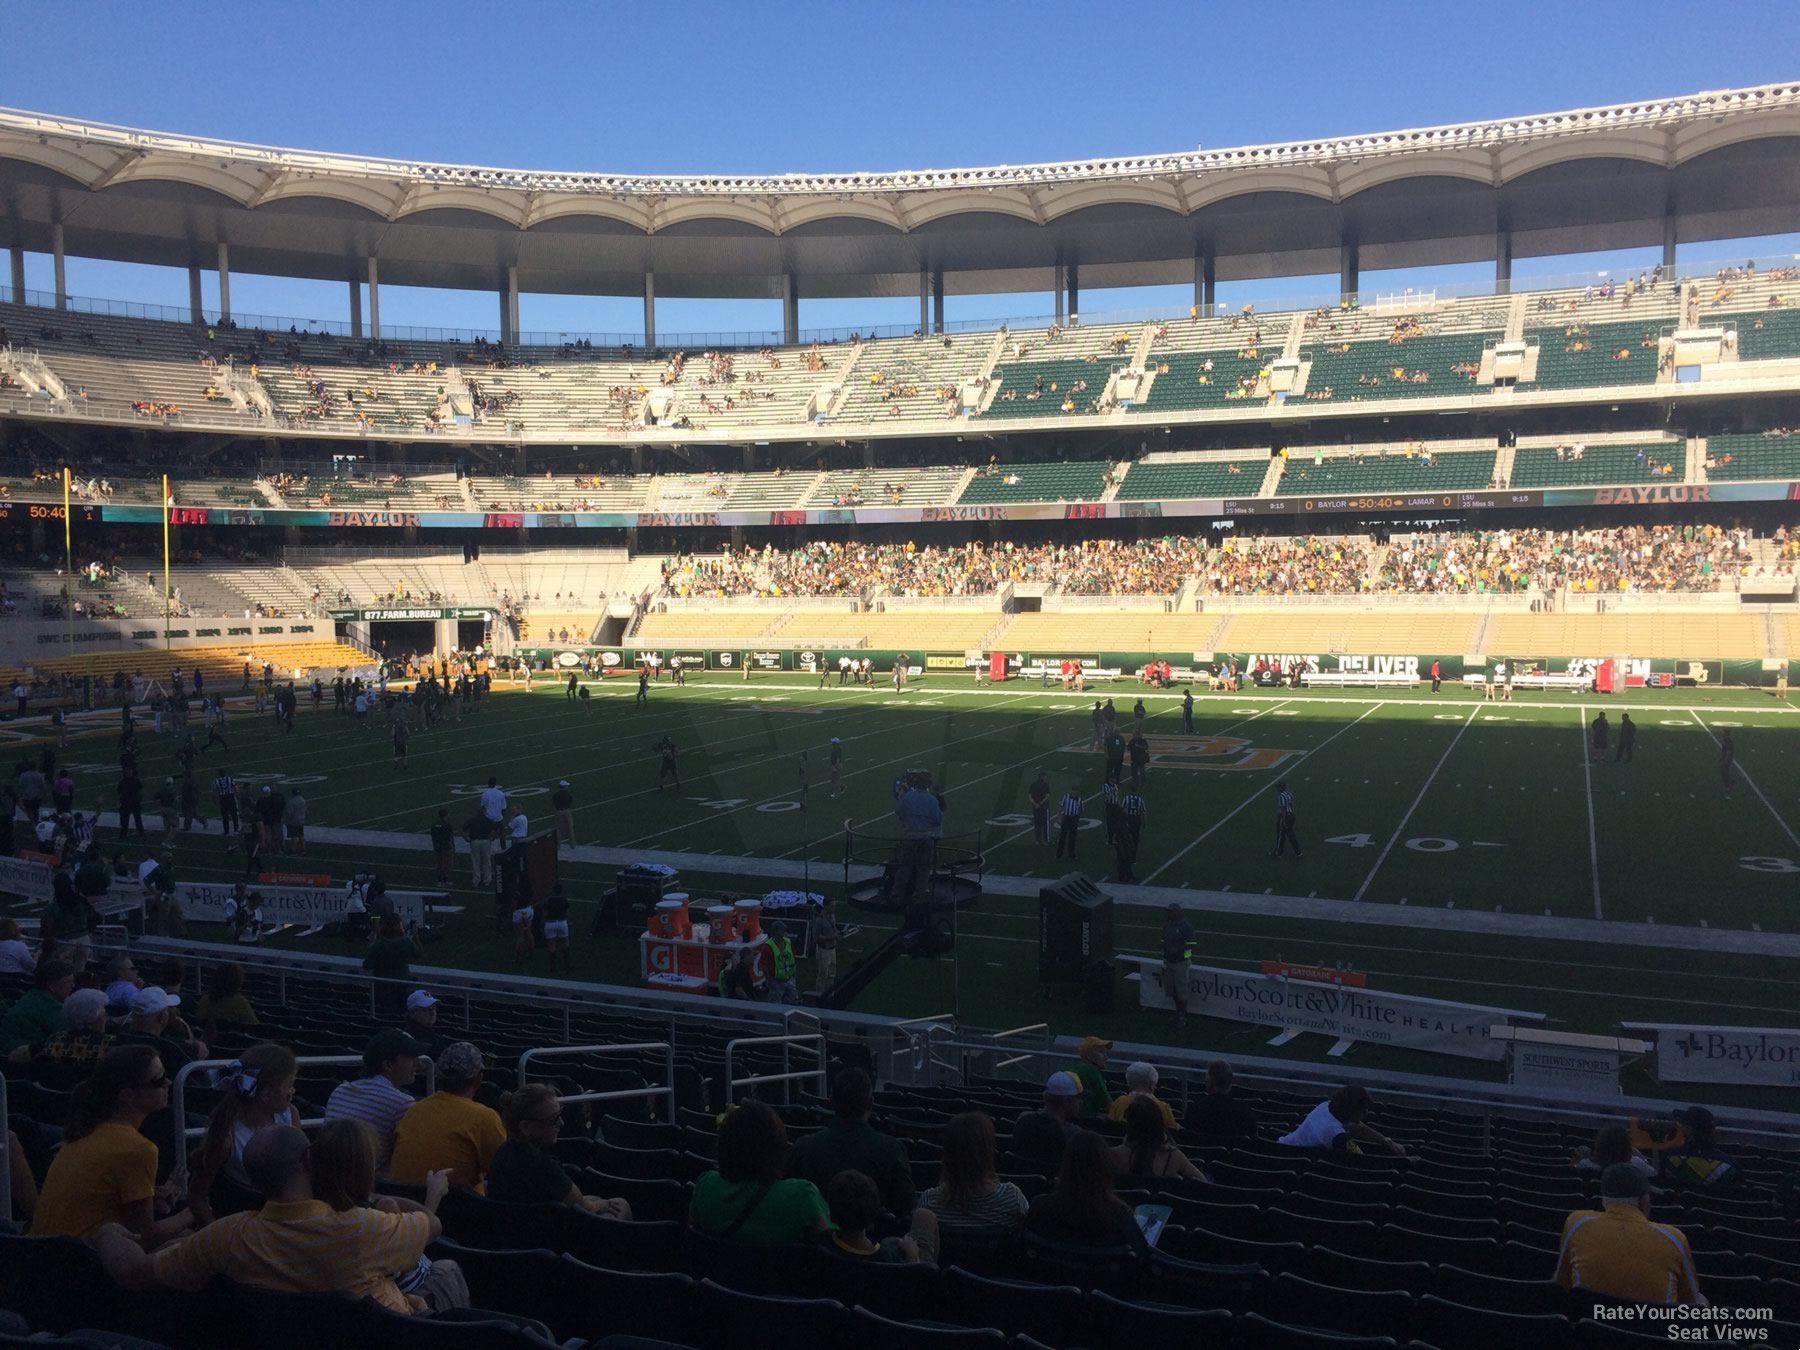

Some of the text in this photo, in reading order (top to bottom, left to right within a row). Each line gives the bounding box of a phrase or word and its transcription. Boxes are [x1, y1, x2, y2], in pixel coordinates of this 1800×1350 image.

[1305, 501, 1313, 510] 0
[1358, 499, 1393, 508] 50:40
[1408, 498, 1435, 506] LAMAR
[1443, 497, 1451, 506] 0
[1594, 485, 1711, 504] BAYLOR
[30, 506, 66, 519] 50:40
[329, 512, 420, 527] BAYLOR
[638, 513, 721, 527] BAYLOR
[921, 507, 1008, 521] BAYLOR
[364, 609, 441, 620] 877.FARM.BUREAU
[1339, 655, 1418, 675] DELIVER
[697, 799, 801, 812] 40
[1323, 833, 1460, 852] 40
[1082, 920, 1090, 956] BAYLOR
[651, 946, 671, 971] G
[1190, 973, 1490, 1038] aylorScott&White HEALTH
[1237, 1006, 1392, 1042] BaylorScottandWite.com
[1706, 1033, 1800, 1068] Baylor
[1522, 1053, 1611, 1070] SOUTHWEST SPORTS
